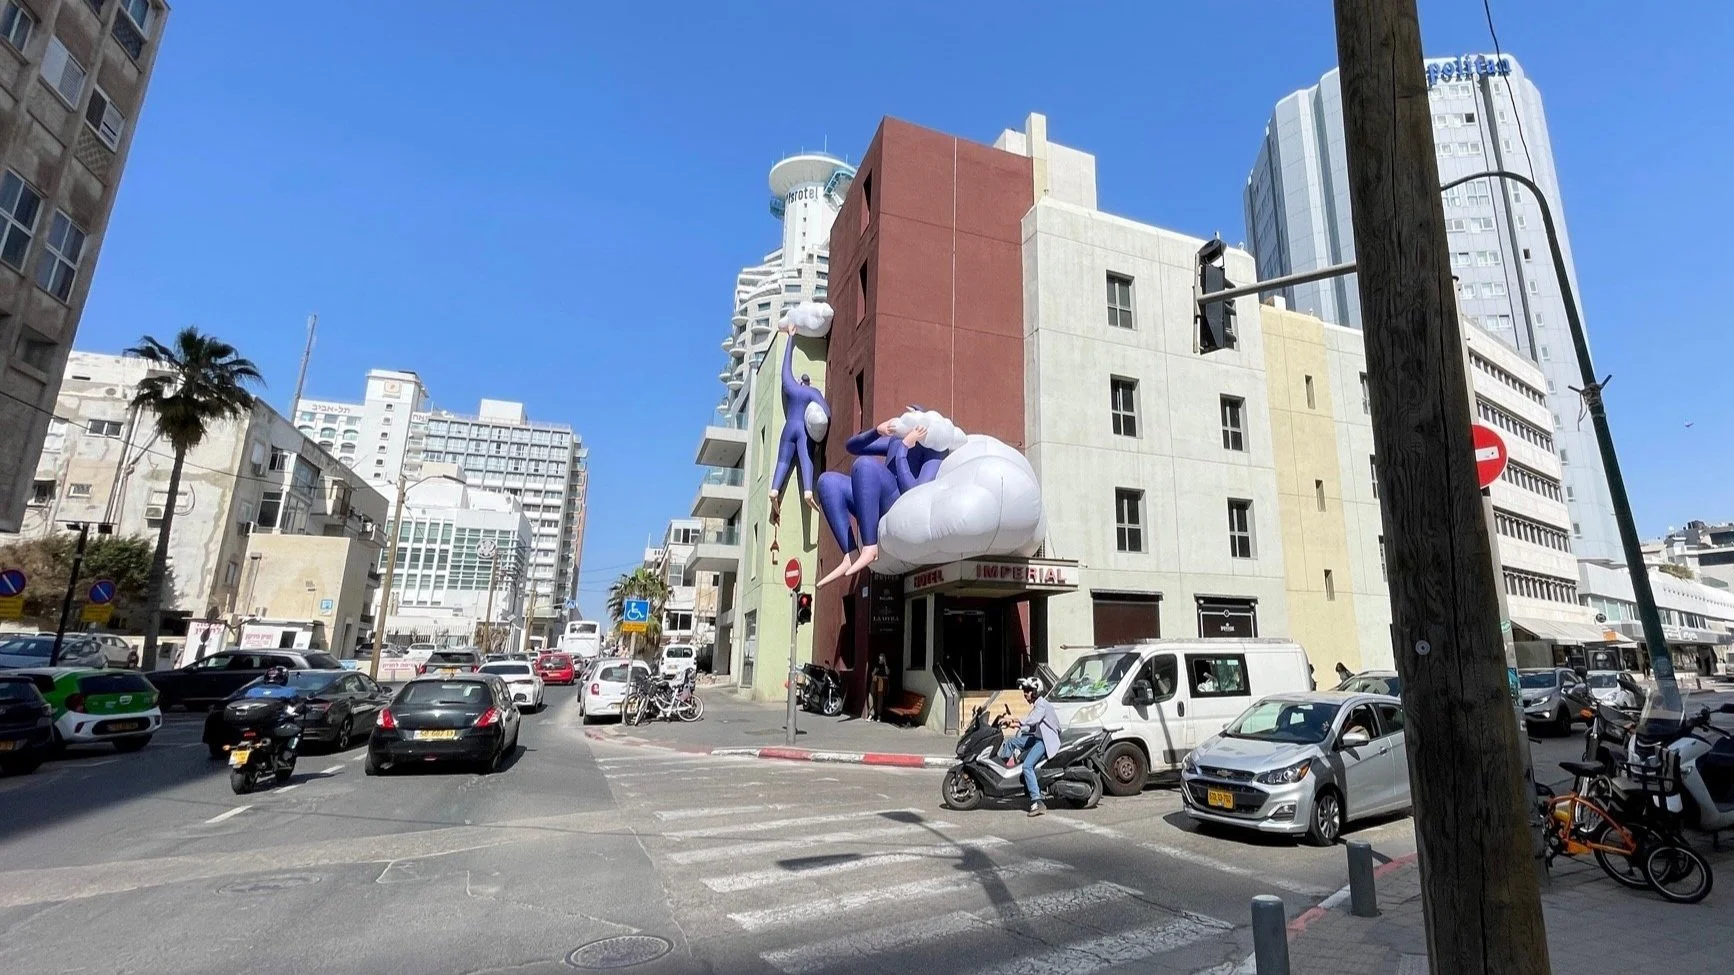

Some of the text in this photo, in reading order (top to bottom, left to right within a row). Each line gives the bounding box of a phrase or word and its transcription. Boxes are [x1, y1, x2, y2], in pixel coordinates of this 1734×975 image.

[1426, 56, 1512, 87] politan
[913, 568, 945, 588] HOTEL
[976, 563, 1067, 584] IMPERIAL
